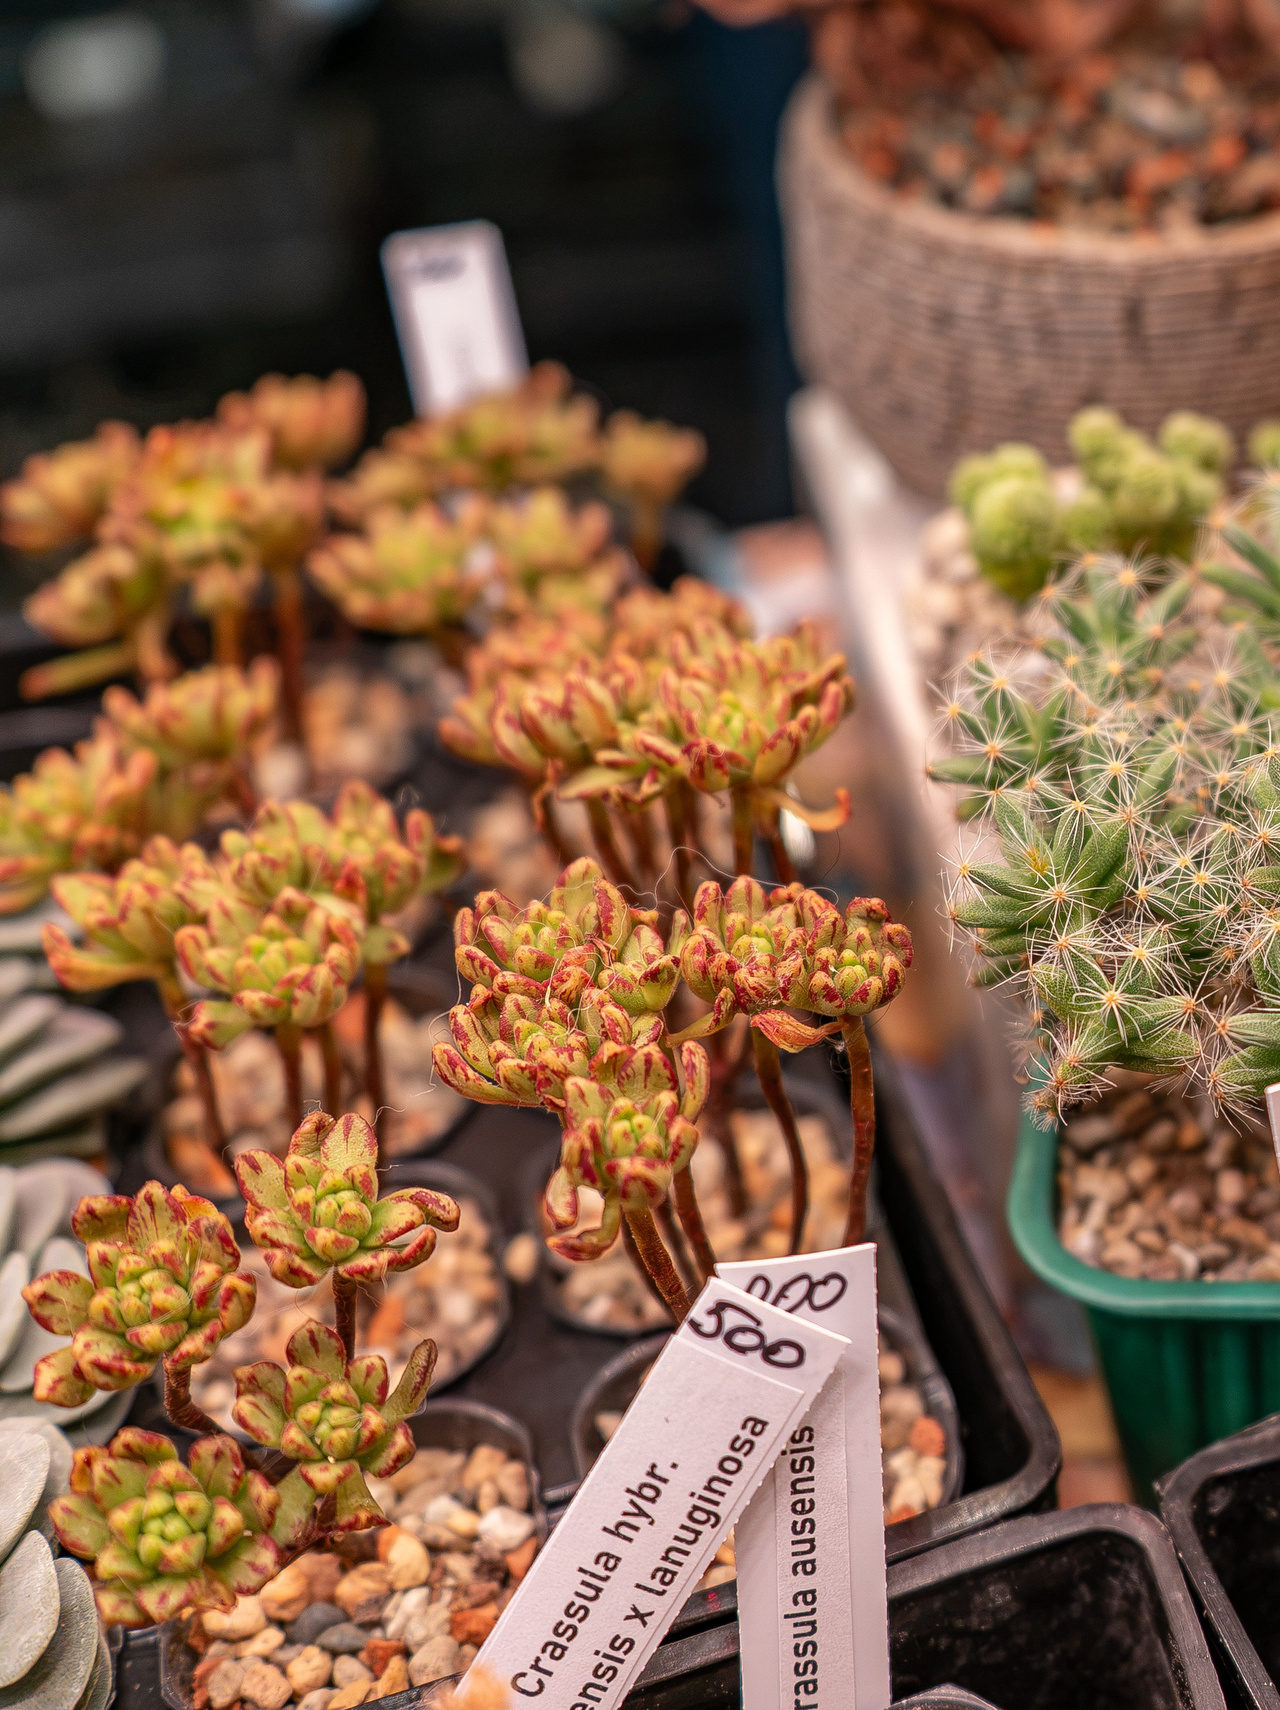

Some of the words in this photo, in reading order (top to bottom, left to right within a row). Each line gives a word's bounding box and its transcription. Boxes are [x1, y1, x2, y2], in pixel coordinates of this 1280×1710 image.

[687, 1300, 806, 1369] 500
[634, 1414, 770, 1597] lanuginosa
[780, 1424, 817, 1577] ausensis
[510, 1549, 622, 1698] Crassula
[603, 1461, 680, 1544] hybr.
[623, 1604, 655, 1628] x
